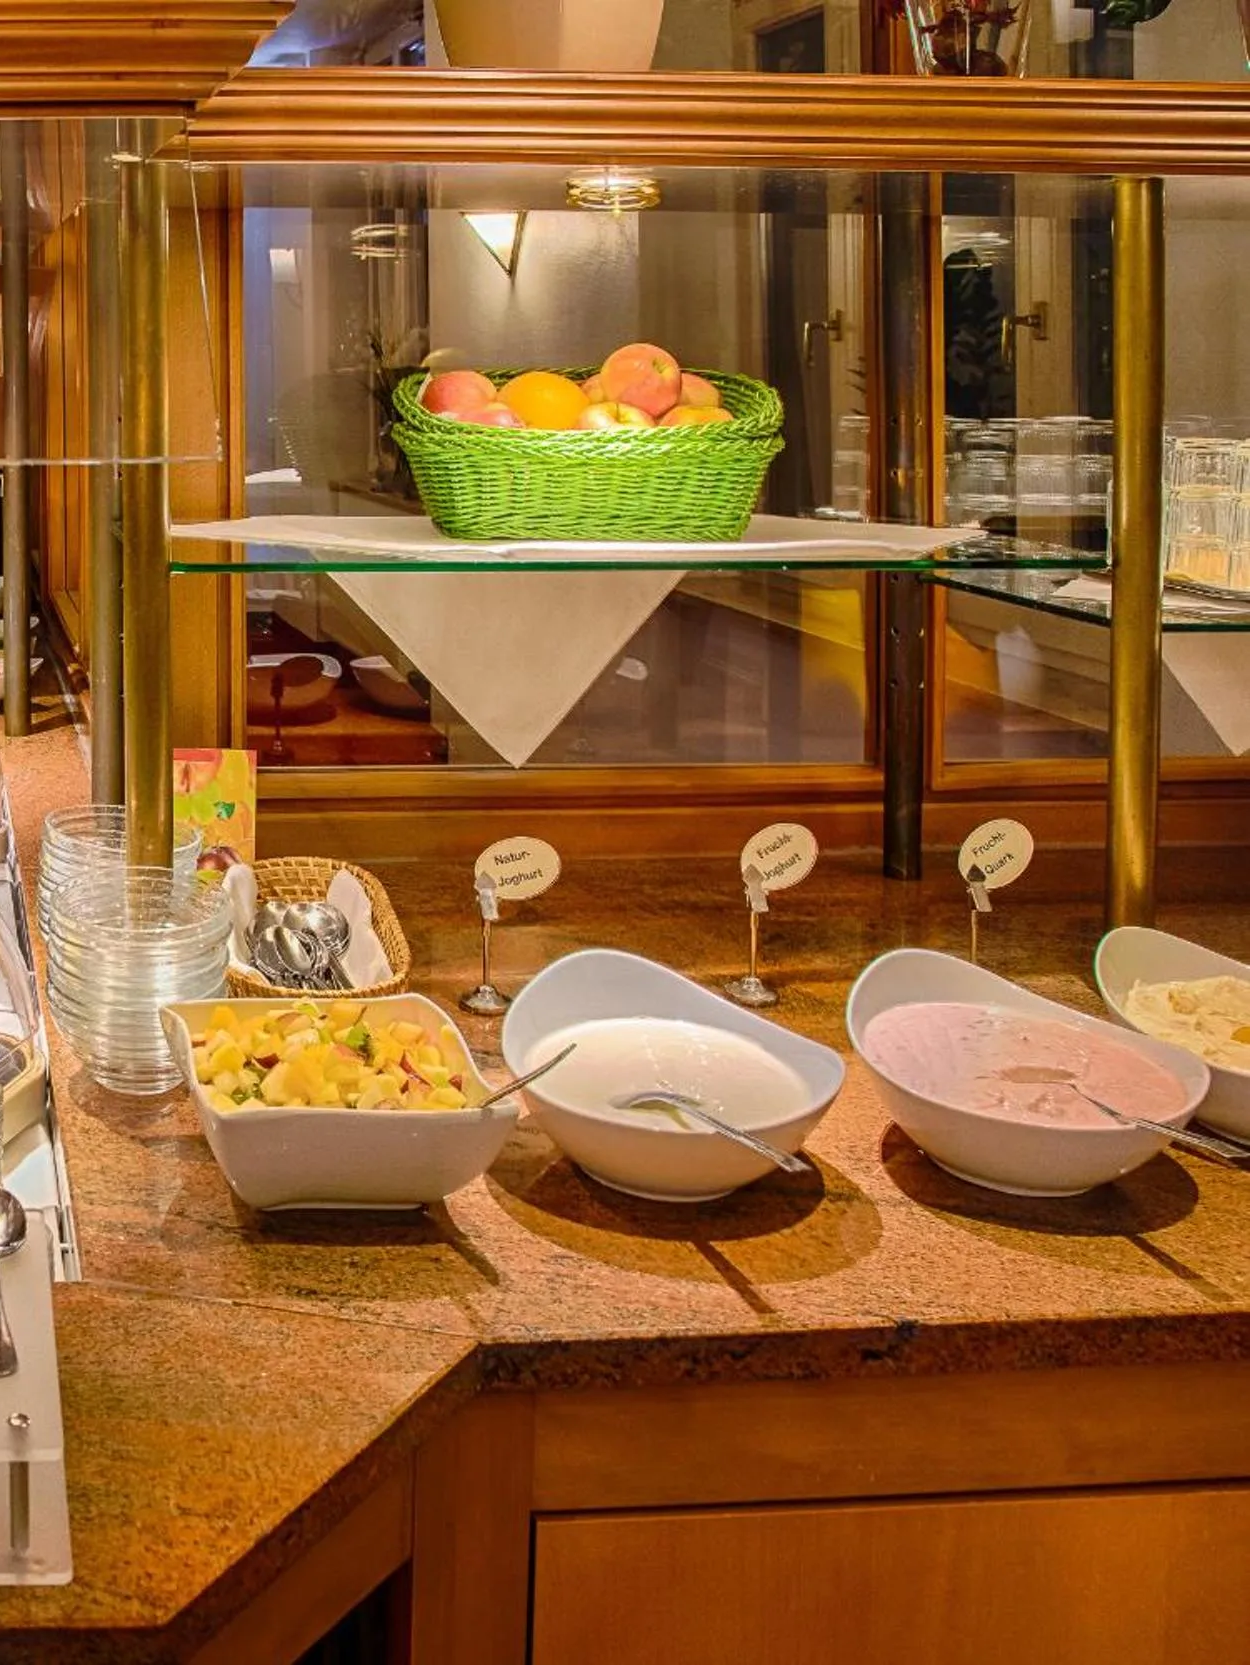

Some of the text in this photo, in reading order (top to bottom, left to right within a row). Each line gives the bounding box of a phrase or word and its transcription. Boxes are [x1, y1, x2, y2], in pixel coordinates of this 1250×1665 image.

[763, 852, 802, 880] Joghurt
[984, 853, 1014, 875] Quark
[498, 868, 543, 887] Joghurt
